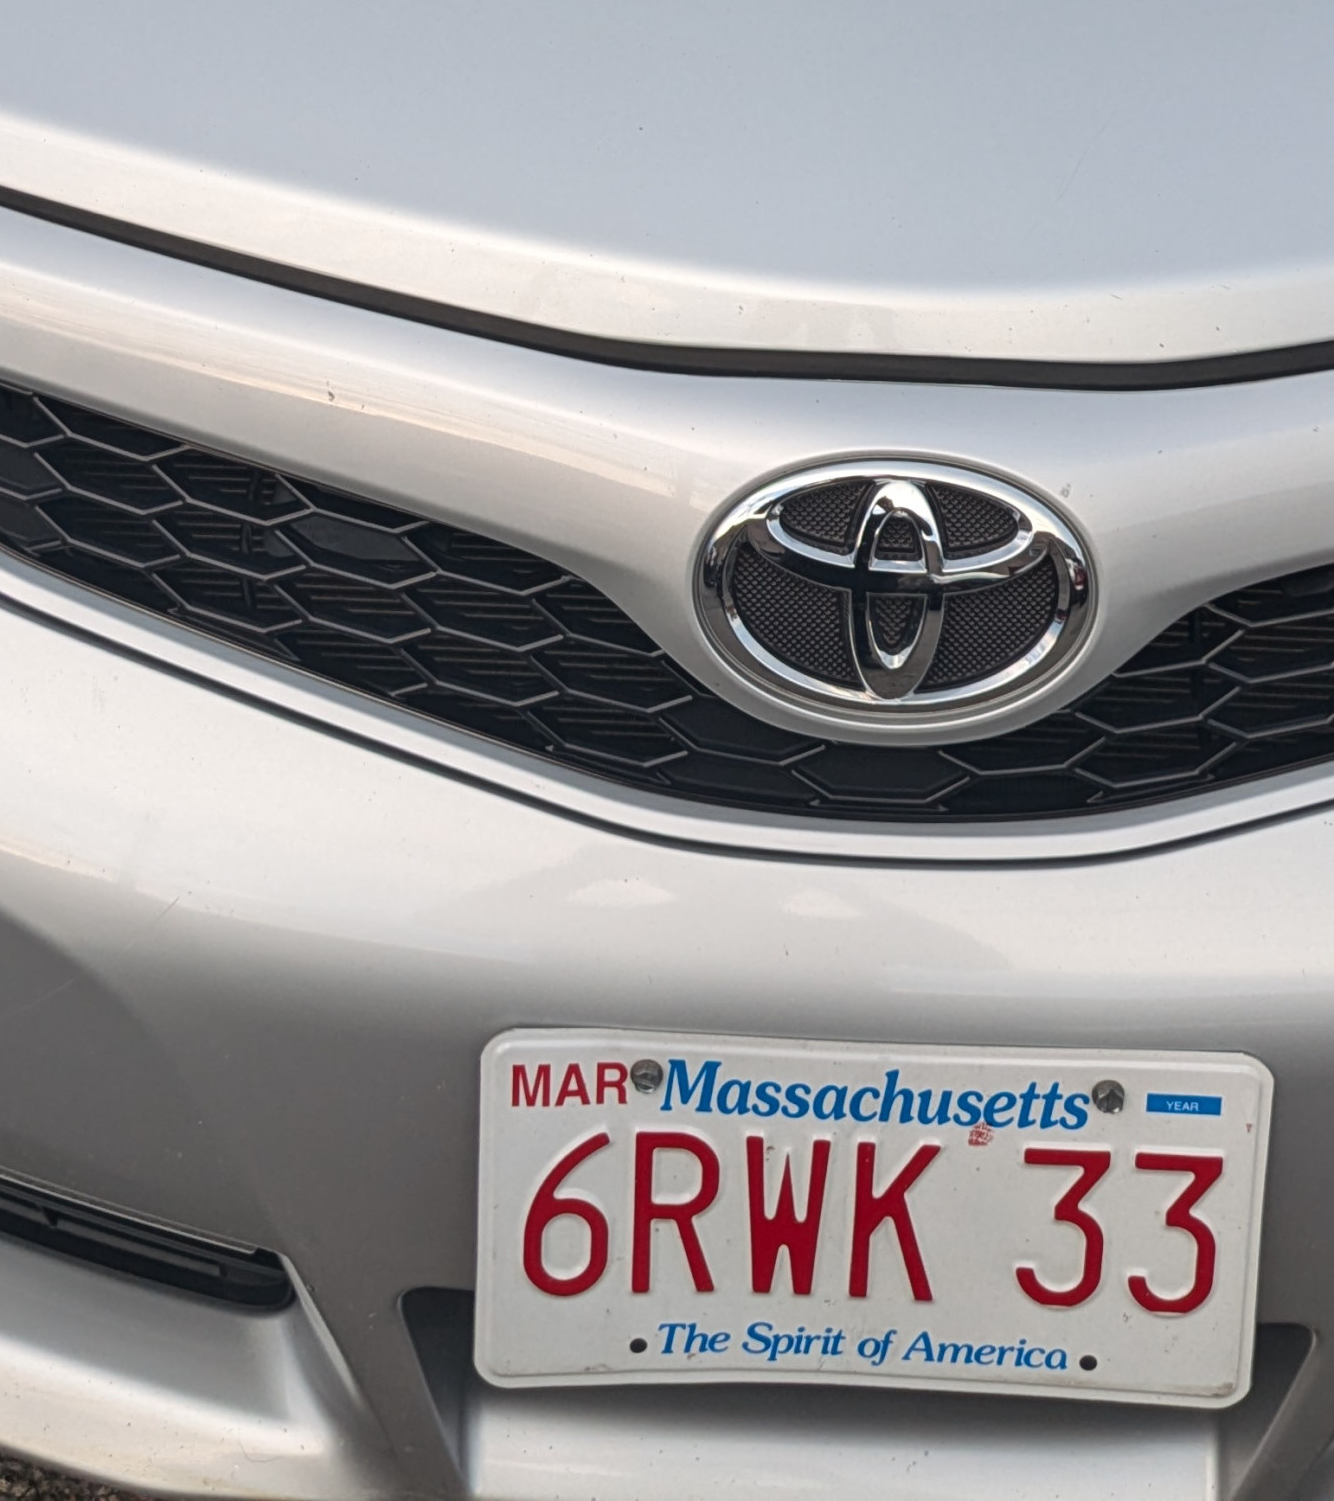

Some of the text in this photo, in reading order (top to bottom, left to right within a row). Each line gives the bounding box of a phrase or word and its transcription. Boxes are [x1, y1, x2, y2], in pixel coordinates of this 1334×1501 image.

[511, 1061, 628, 1107] MAR
[660, 1058, 1090, 1130] Massachusetts
[1166, 1100, 1200, 1112] YEAR
[522, 1131, 1224, 1315] 6RWK 33
[658, 1321, 1068, 1371] The Spirit of America
